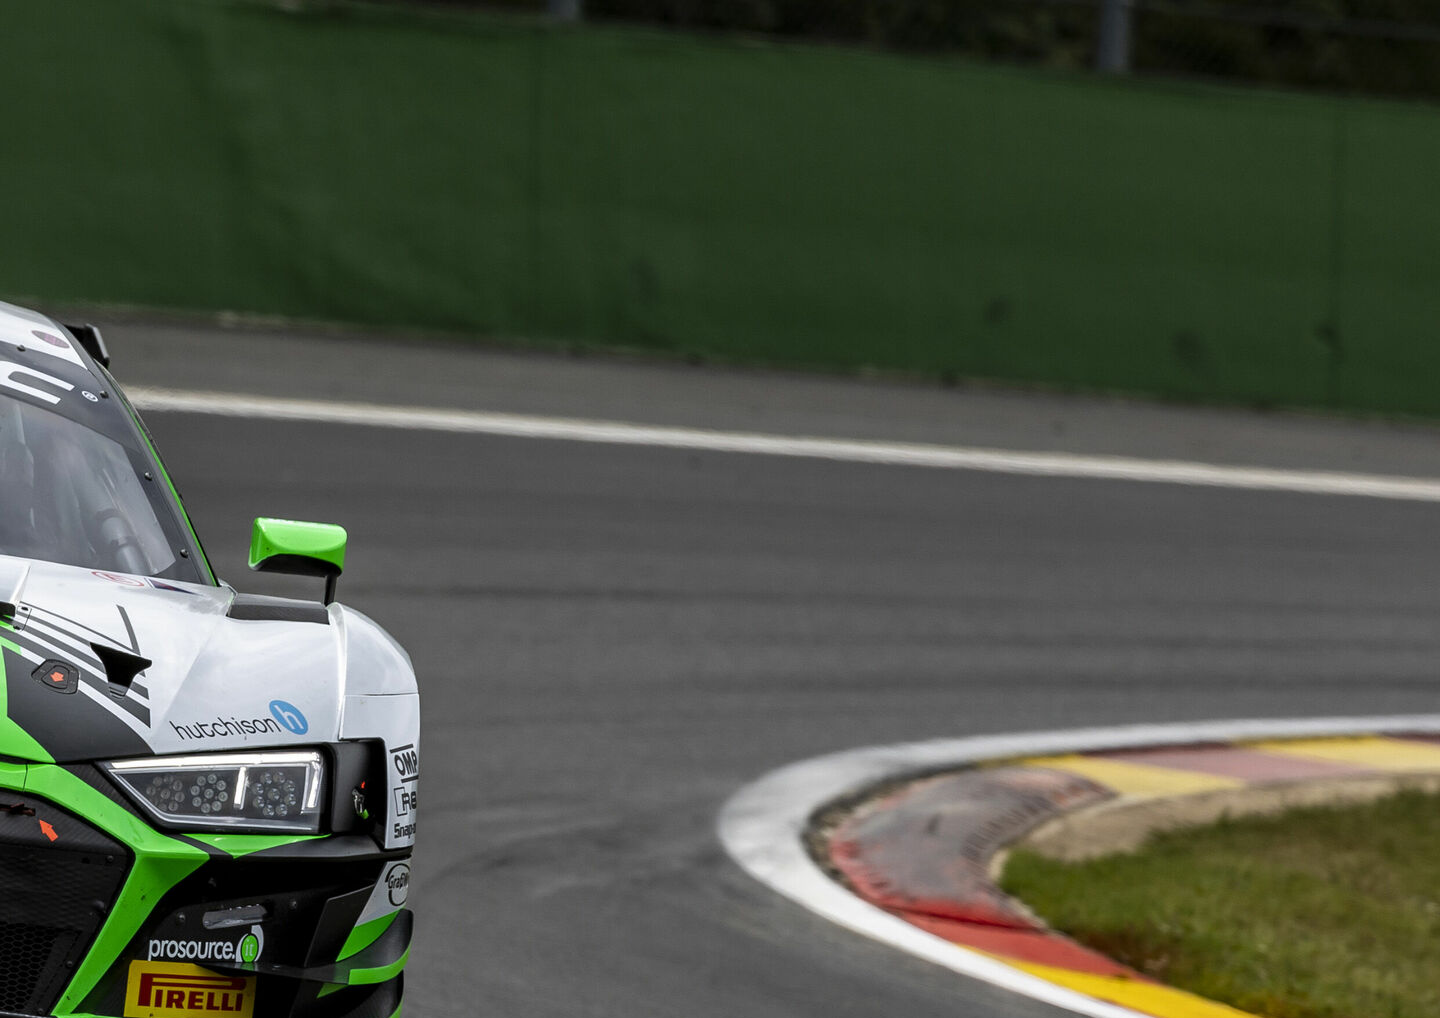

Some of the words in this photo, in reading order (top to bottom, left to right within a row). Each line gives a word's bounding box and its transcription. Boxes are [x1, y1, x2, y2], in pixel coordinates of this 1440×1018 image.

[169, 716, 281, 740] hutchison
[394, 750, 418, 777] OMP
[137, 973, 247, 1012] PIRELLI
